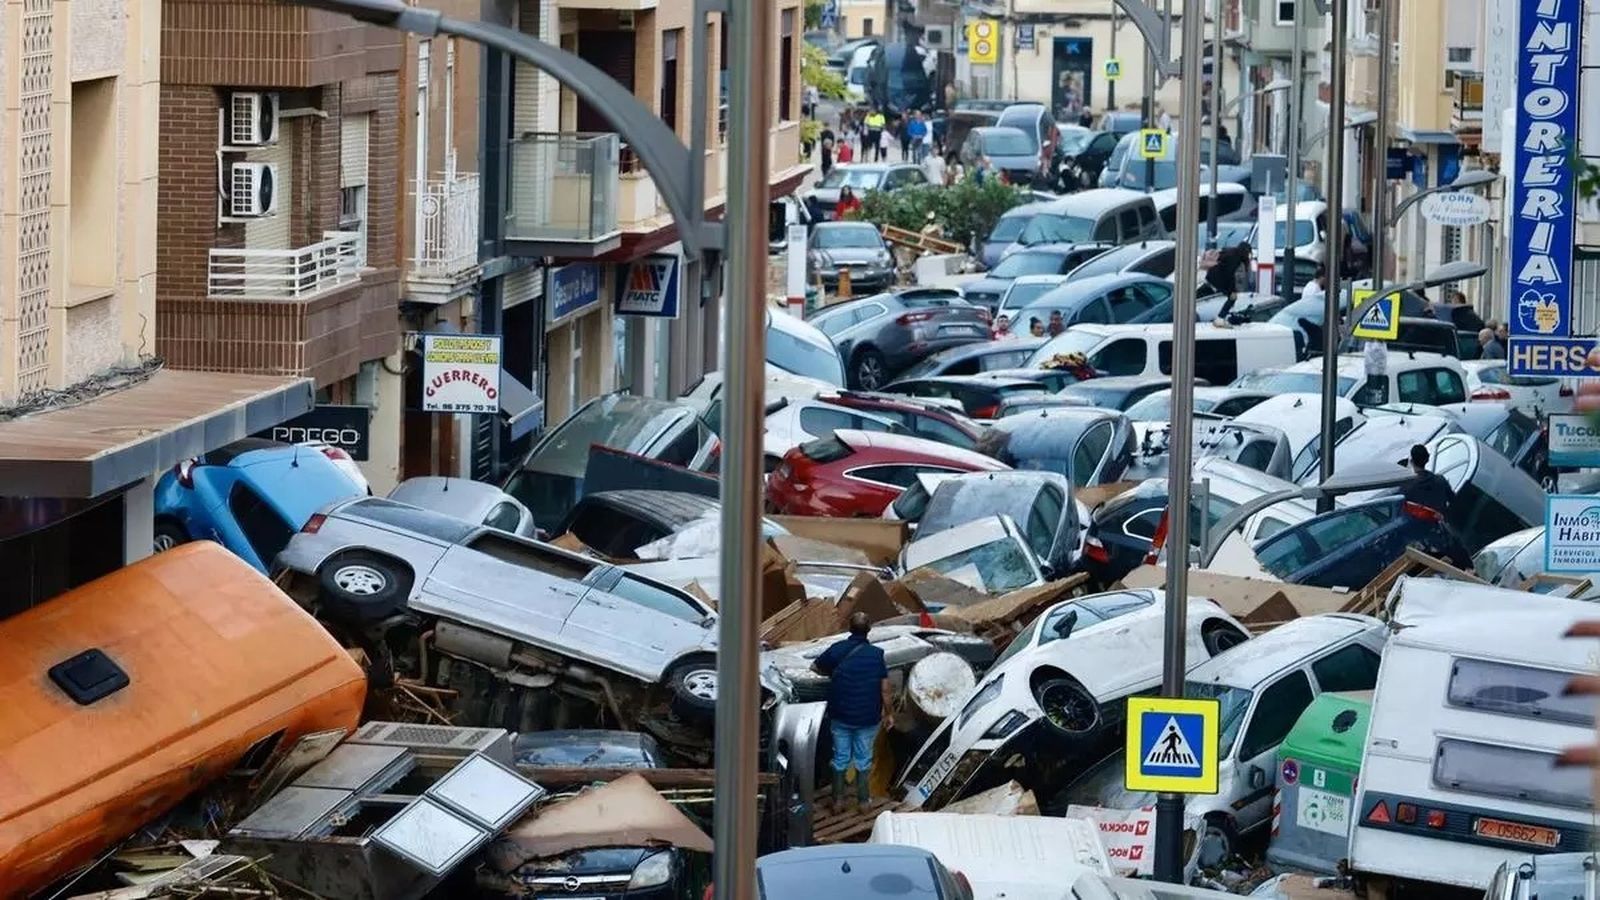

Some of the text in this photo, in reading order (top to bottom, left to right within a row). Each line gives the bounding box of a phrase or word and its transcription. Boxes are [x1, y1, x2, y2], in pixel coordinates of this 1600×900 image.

[1441, 194, 1474, 203] FORN
[628, 292, 659, 302] FIATC
[426, 370, 497, 399] GUERRERO
[273, 427, 358, 444] PREGO
